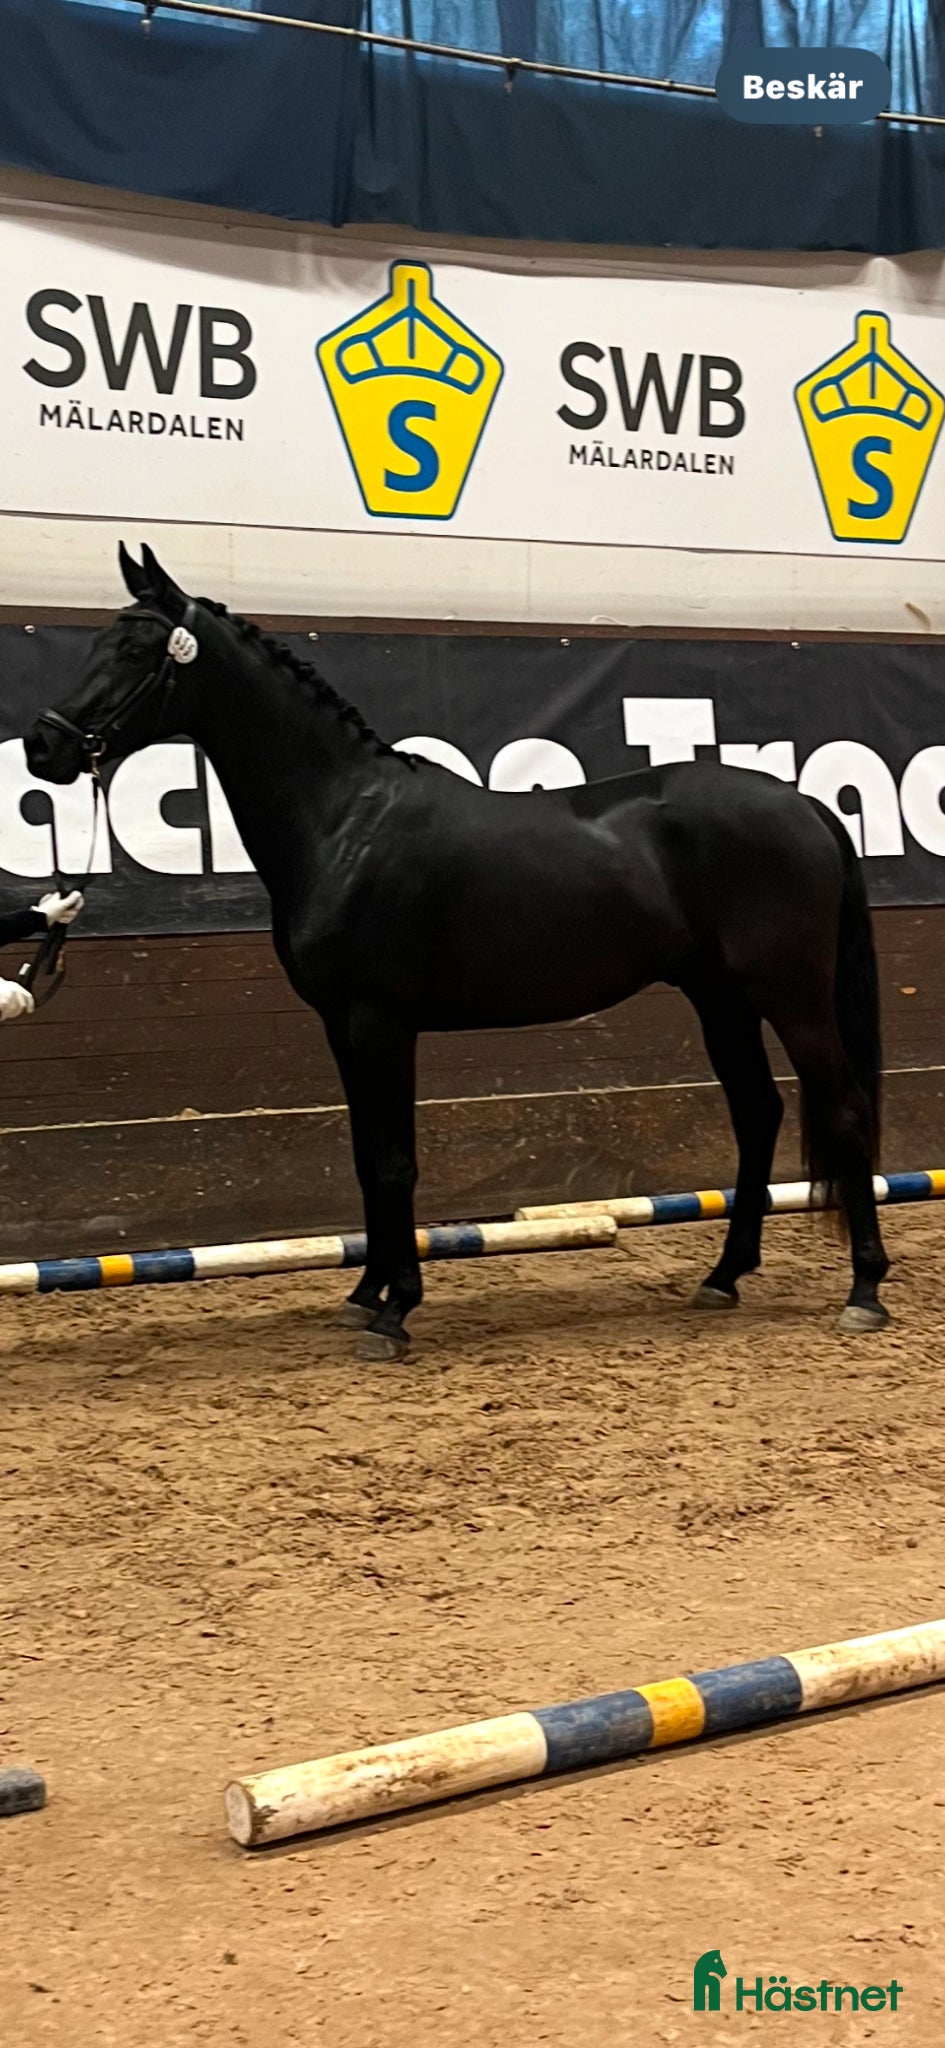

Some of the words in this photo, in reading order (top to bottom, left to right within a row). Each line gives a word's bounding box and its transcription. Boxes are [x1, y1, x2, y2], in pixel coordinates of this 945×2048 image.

[22, 288, 257, 400] SWB
[40, 399, 244, 441] MÄLARDALEN
[556, 341, 746, 438] SWB
[384, 400, 440, 493] S
[569, 440, 735, 475] MÄLARDALEN
[848, 436, 894, 519] S
